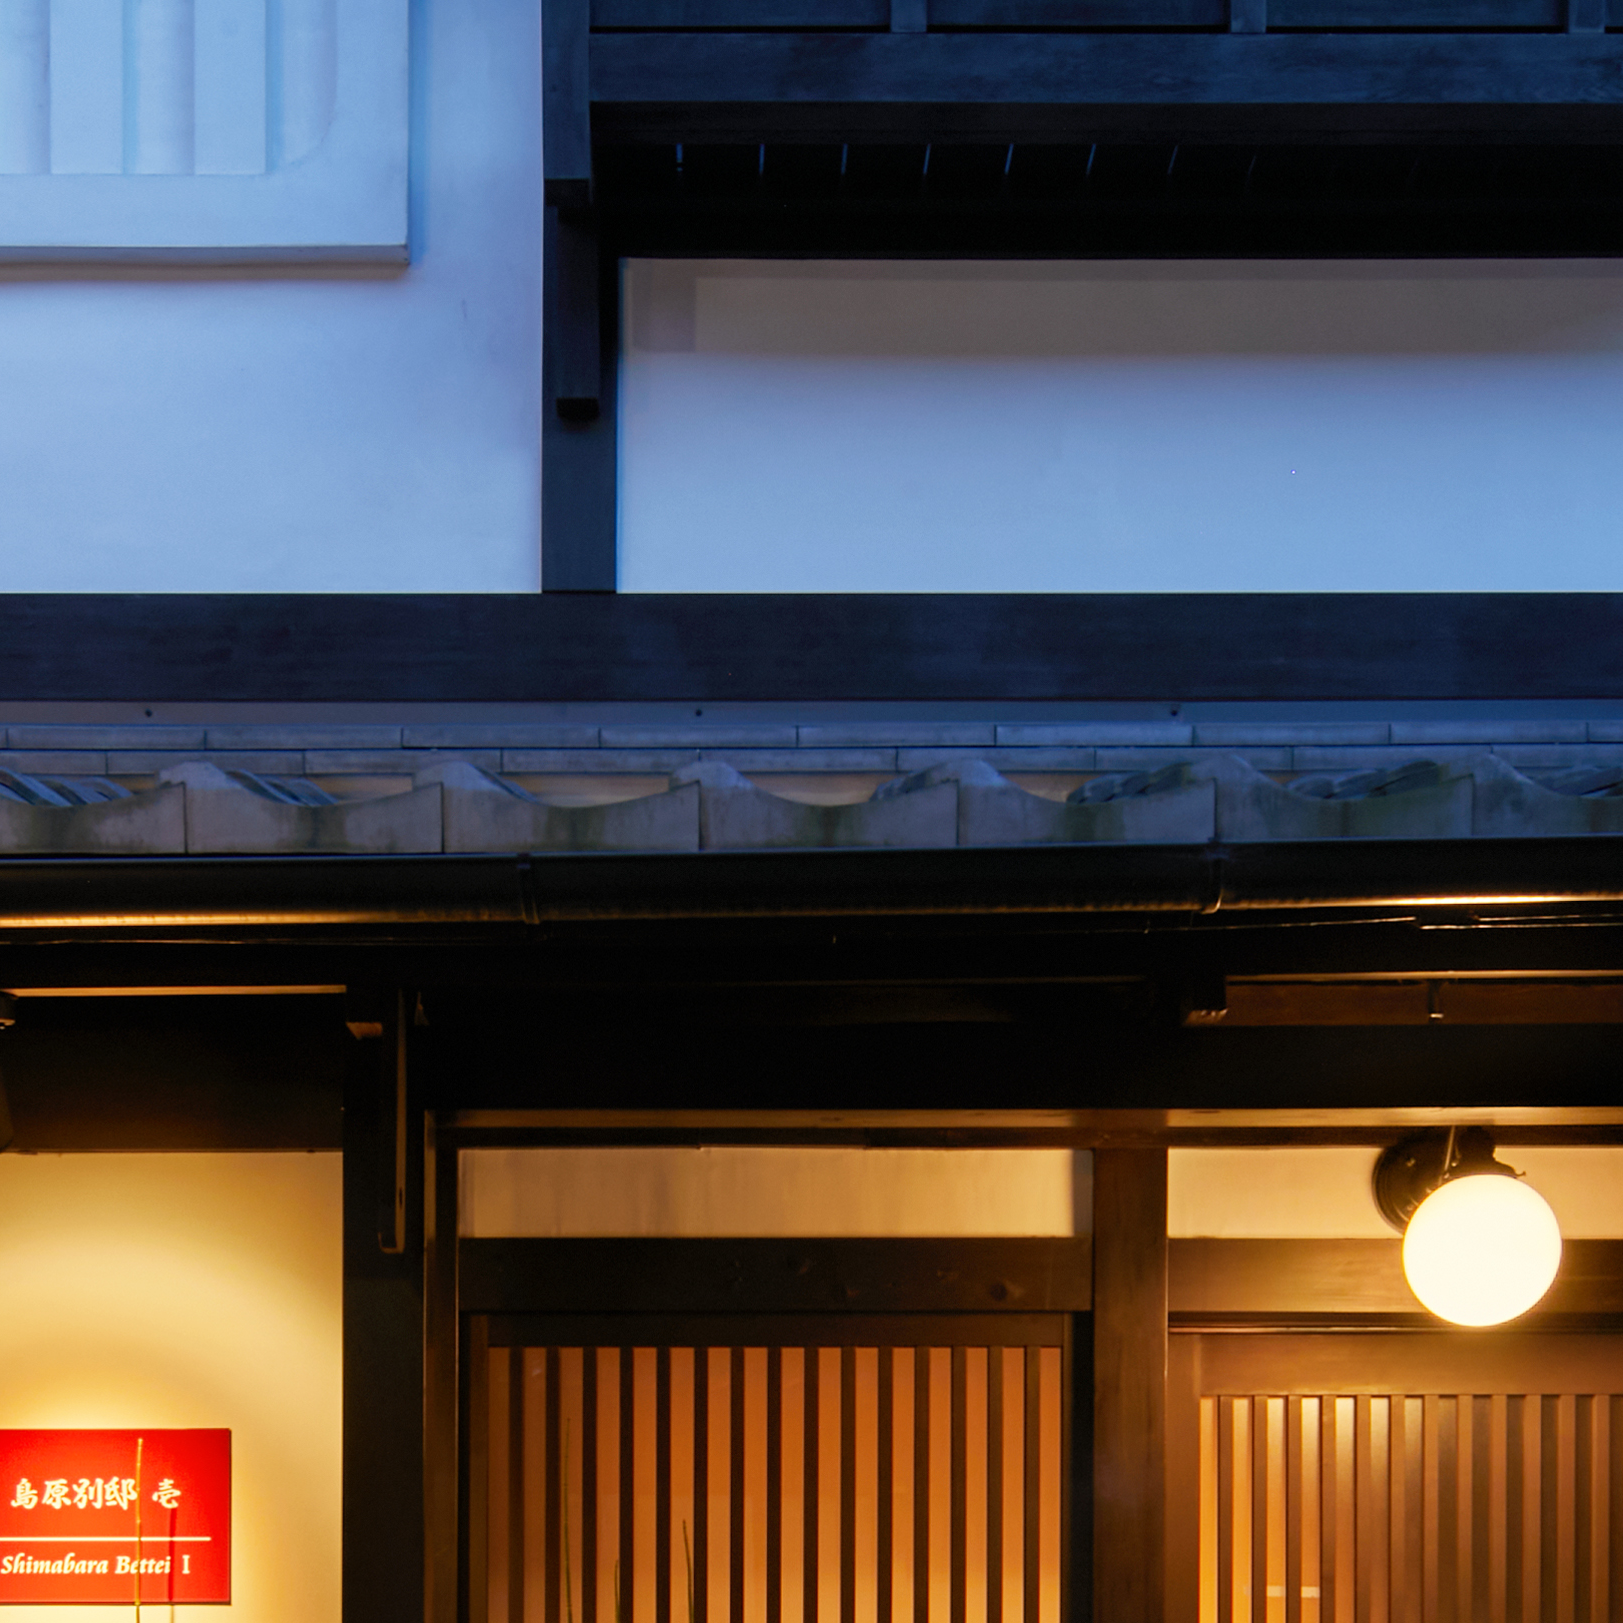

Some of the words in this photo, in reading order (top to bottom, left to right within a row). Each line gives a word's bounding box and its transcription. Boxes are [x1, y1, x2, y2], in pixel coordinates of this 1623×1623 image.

[10, 1476, 138, 1510] 島原別邸
[151, 1478, 181, 1509] 壱
[0, 1553, 109, 1574] Shimabara
[115, 1555, 171, 1574] Bettei
[181, 1555, 190, 1574] I
